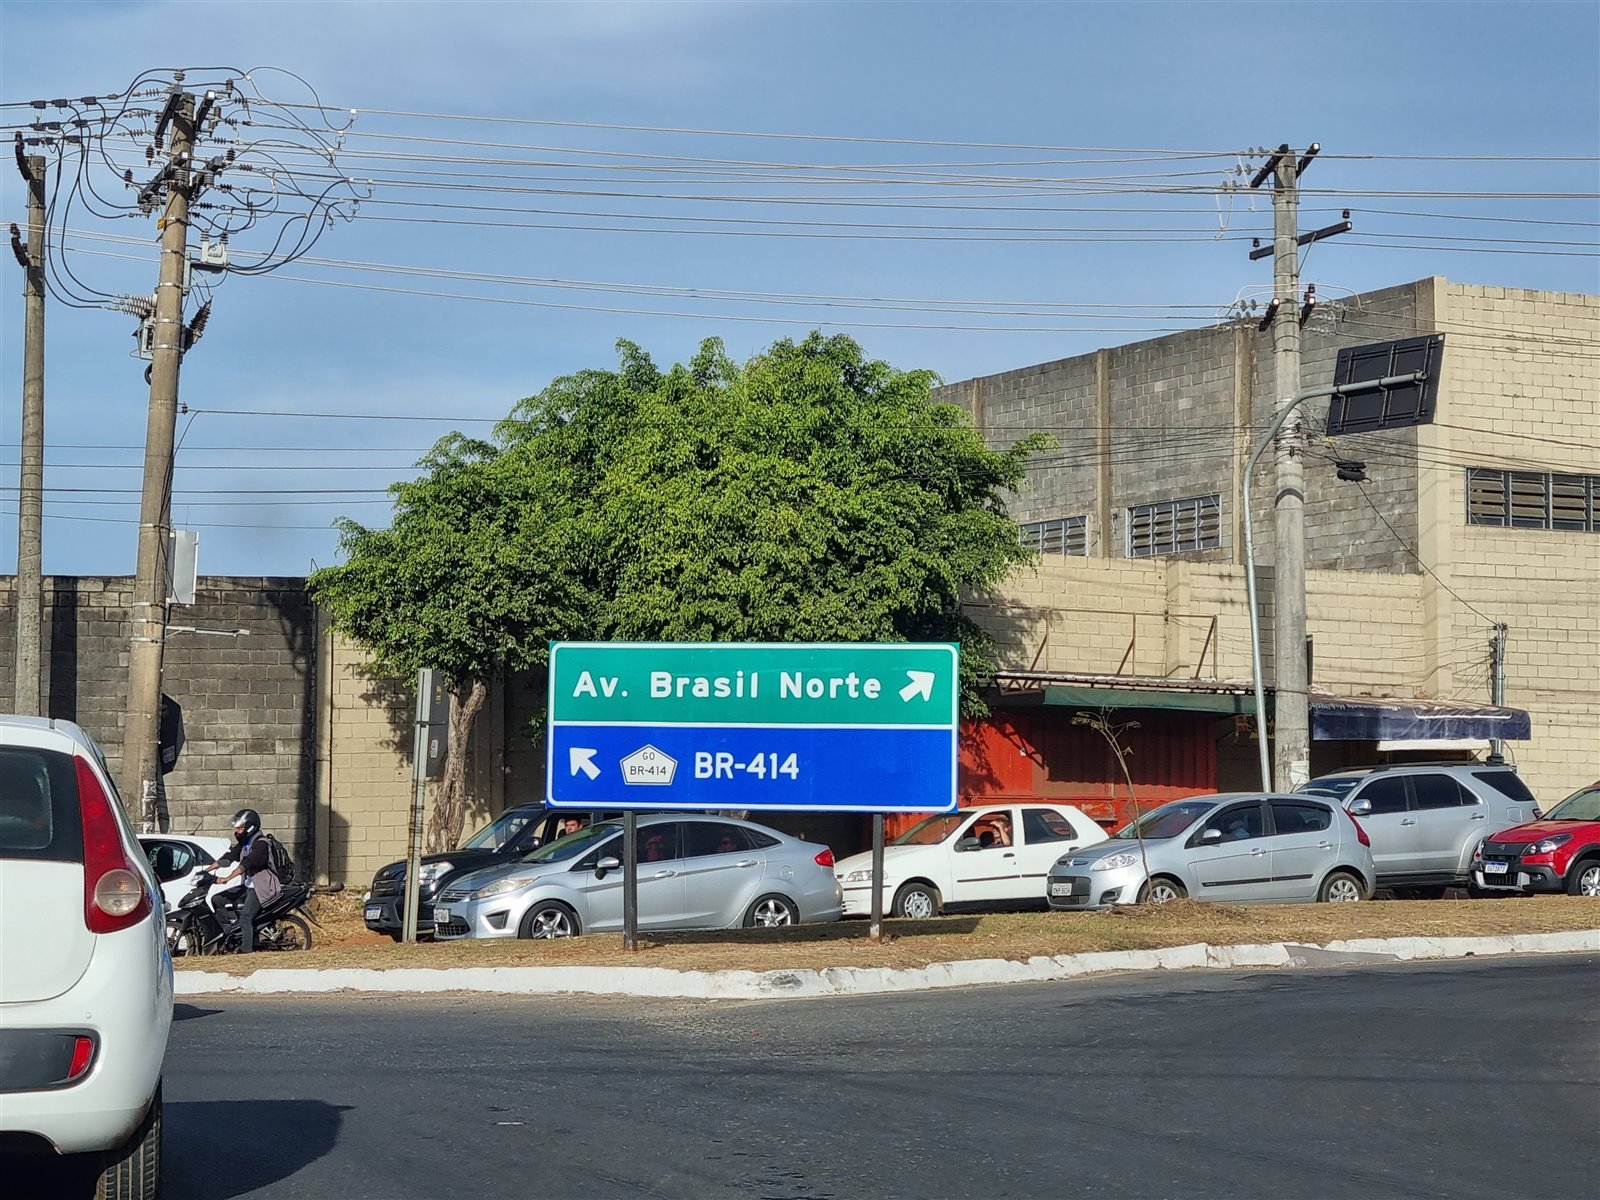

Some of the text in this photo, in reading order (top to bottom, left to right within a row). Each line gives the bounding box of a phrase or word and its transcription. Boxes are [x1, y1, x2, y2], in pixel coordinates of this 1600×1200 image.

[573, 670, 881, 699] Av. Brasil Norte
[642, 751, 656, 761] GO
[630, 765, 667, 776] BR-414
[694, 752, 800, 780] BR-414
